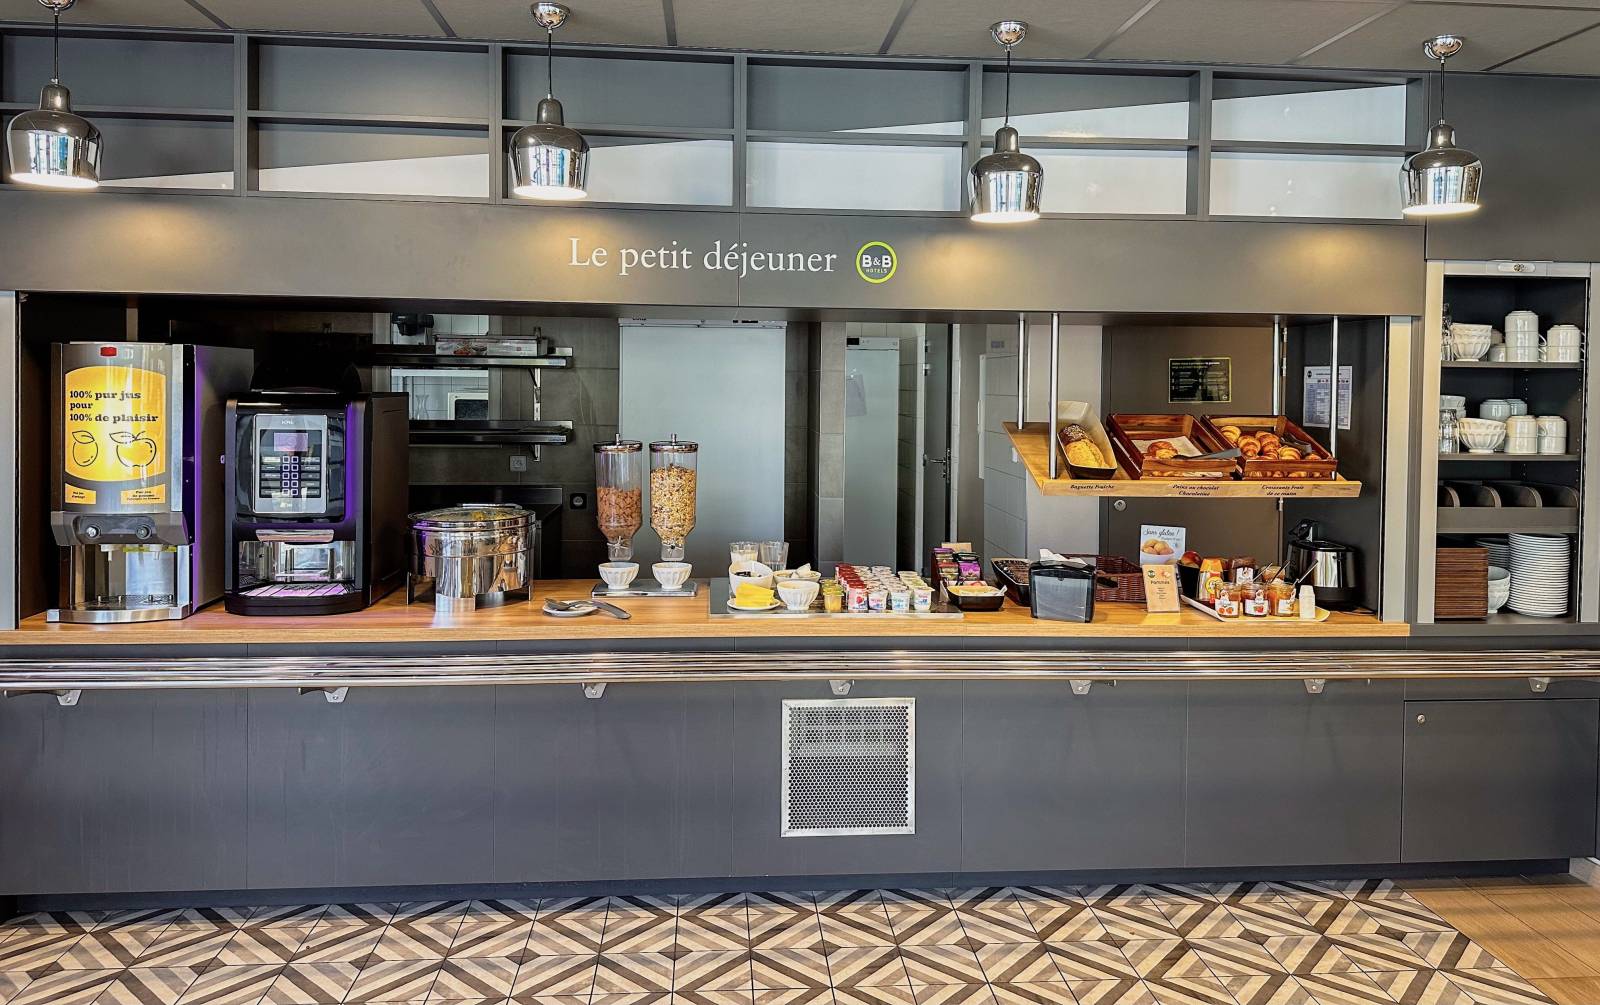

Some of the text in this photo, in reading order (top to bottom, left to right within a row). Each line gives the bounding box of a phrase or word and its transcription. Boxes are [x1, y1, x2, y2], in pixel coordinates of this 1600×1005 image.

[568, 237, 838, 278] Le petit déjeuner
[862, 254, 892, 268] B&B
[70, 390, 142, 401] 100% pur jus
[70, 402, 93, 411] pour
[70, 413, 159, 424] 100% de plaisir
[1143, 528, 1157, 536] Sans
